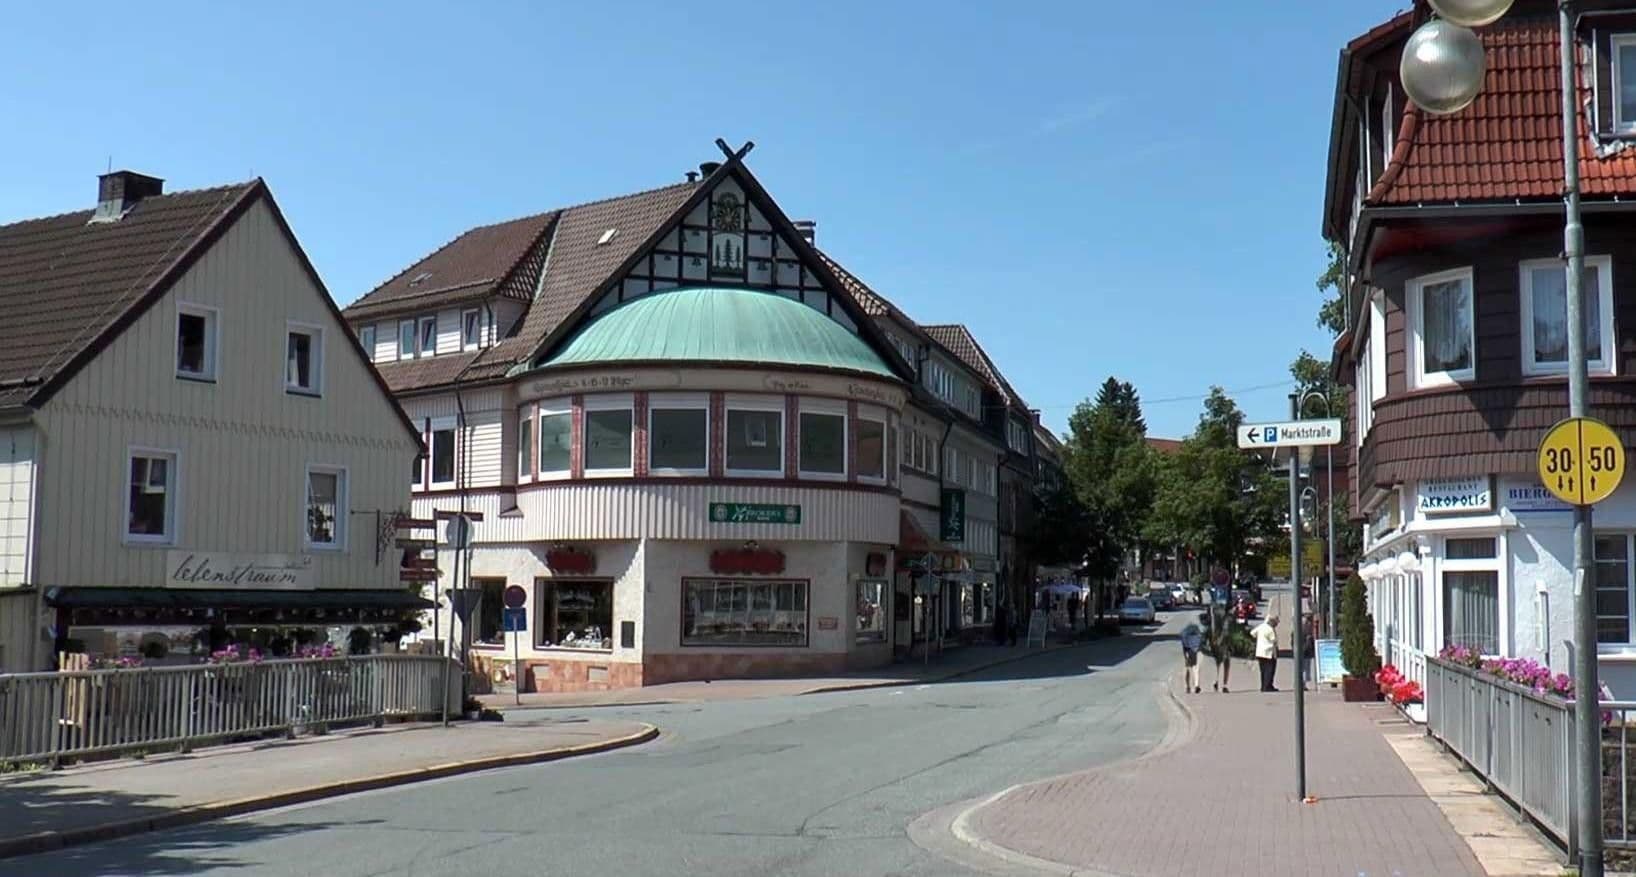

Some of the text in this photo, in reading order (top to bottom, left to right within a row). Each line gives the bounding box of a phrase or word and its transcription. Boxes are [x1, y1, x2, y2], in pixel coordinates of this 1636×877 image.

[1266, 425, 1332, 441] P Marktstraße
[1546, 447, 1572, 473] 30
[1590, 445, 1616, 472] 50
[1421, 493, 1487, 508] AKROPOLIS
[1508, 487, 1552, 500] BIERG
